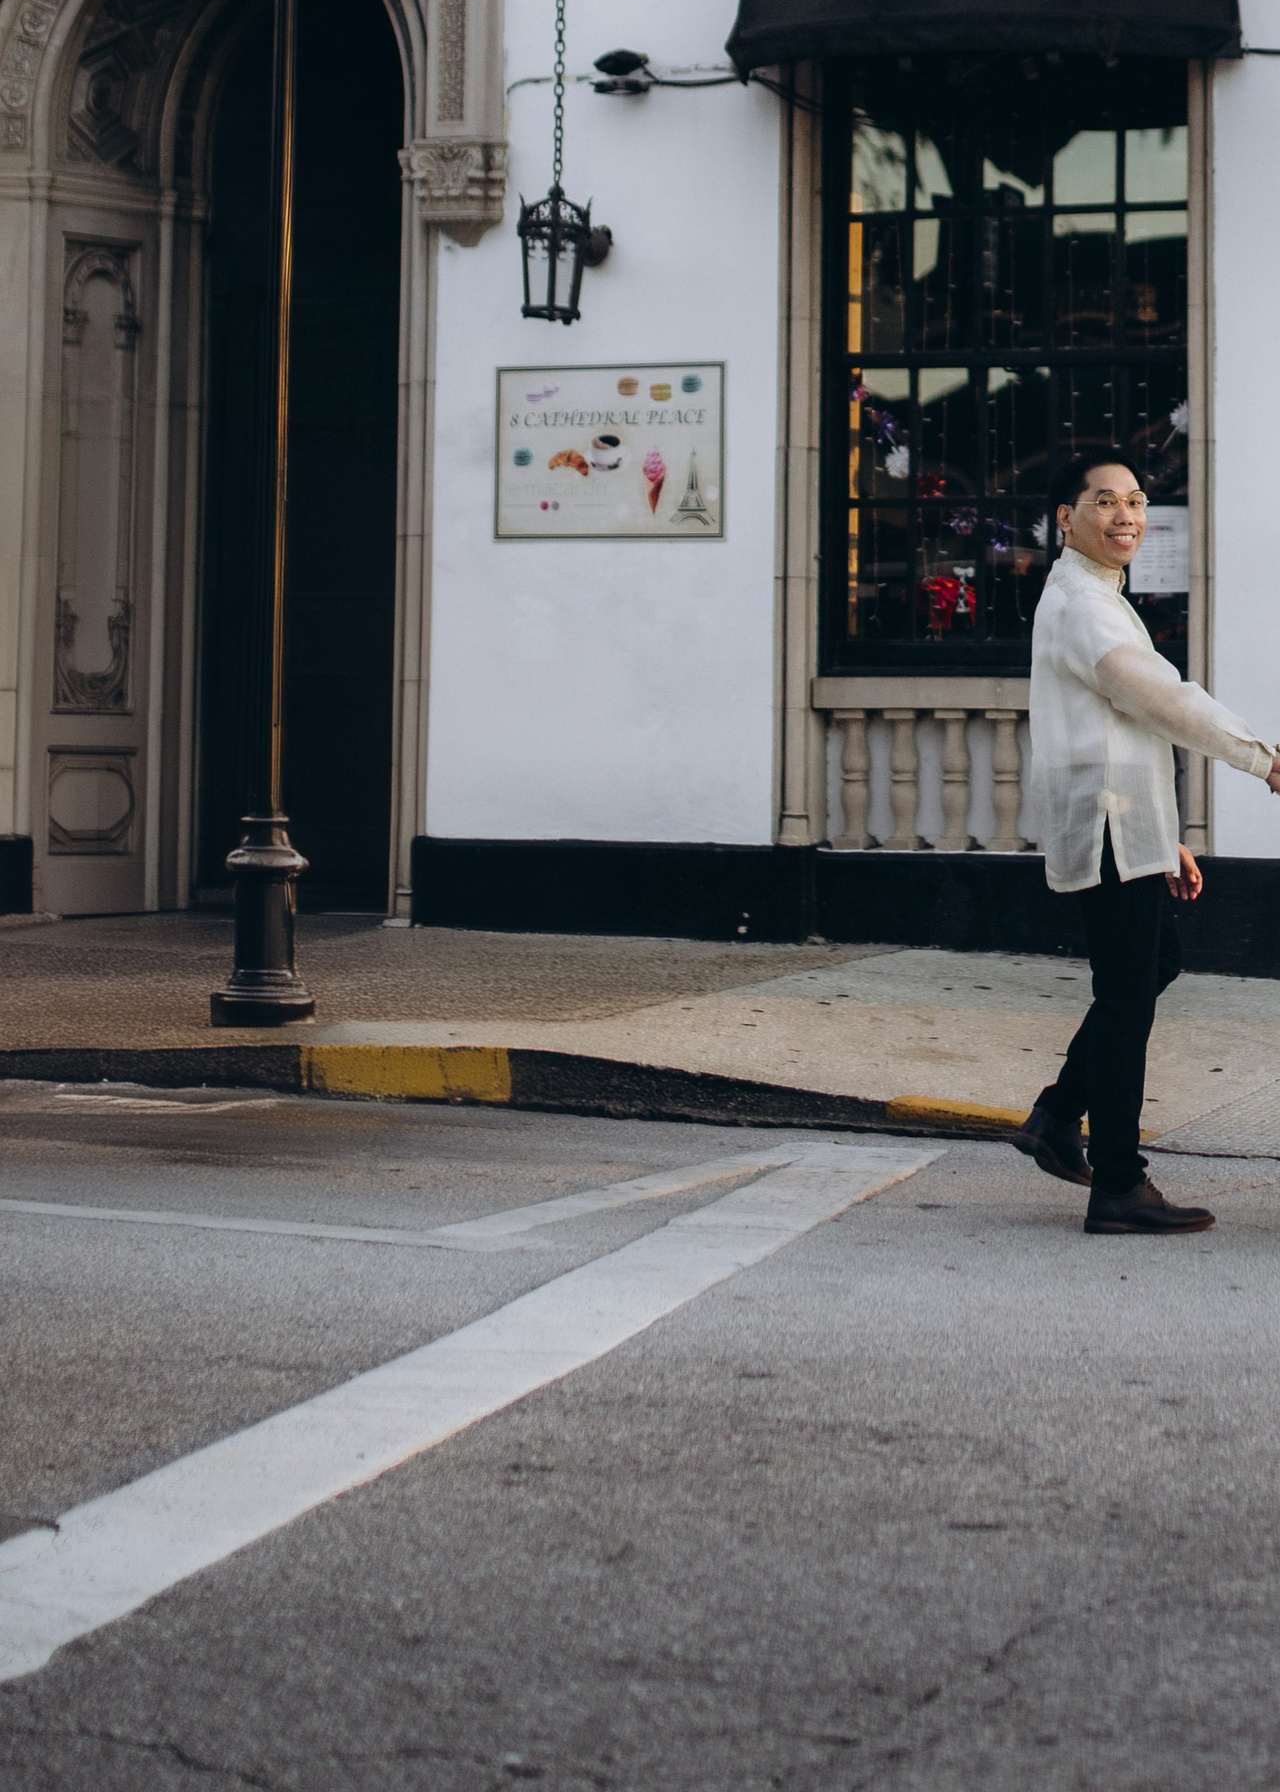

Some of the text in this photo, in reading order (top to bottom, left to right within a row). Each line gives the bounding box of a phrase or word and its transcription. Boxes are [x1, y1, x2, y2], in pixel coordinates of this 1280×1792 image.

[509, 409, 706, 427] 8 CATHEDRAL PLACE
